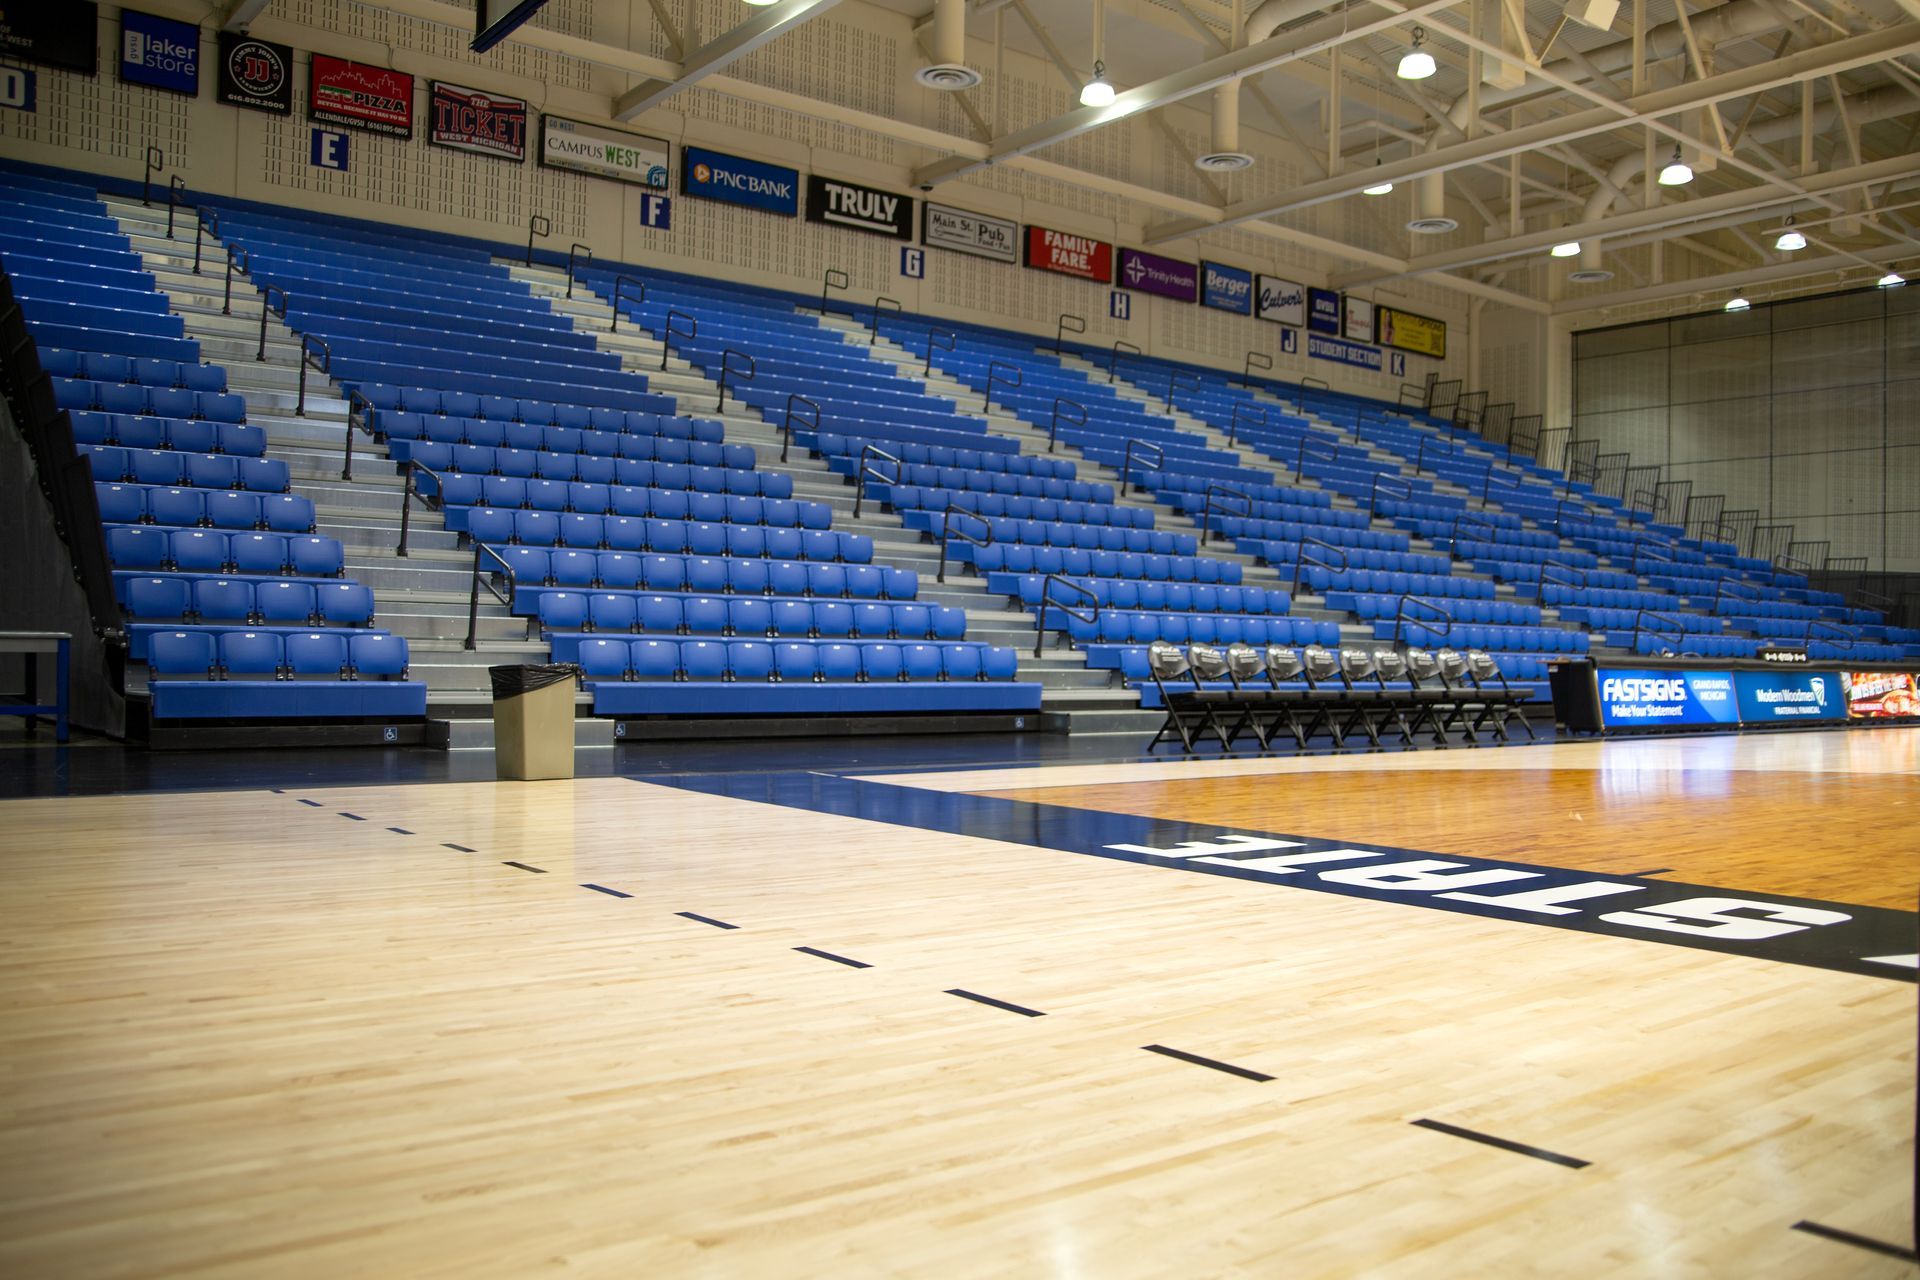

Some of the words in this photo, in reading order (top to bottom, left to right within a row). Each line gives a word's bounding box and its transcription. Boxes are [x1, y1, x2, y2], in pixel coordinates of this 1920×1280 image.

[146, 34, 196, 60] laker
[235, 47, 256, 63] JIMMY
[145, 53, 196, 76] store
[244, 56, 270, 83] JJ
[352, 91, 407, 115] PIZZA
[470, 97, 490, 109] THE
[434, 97, 524, 145] TICKET
[549, 119, 558, 129] GO
[560, 121, 576, 132] WEST
[321, 133, 340, 167] E
[440, 132, 470, 142] WEST
[471, 136, 518, 153] MICHIGAN
[548, 136, 603, 159] CAMPUS
[605, 144, 641, 169] WEST
[652, 174, 667, 187] CW
[649, 196, 663, 226] F
[825, 183, 898, 222] TRULY
[932, 214, 957, 229] Main
[960, 220, 973, 232] St.
[978, 224, 1005, 242] Pub
[1044, 230, 1098, 256] FAMILY
[906, 250, 921, 276] G
[1206, 269, 1250, 295] Berger
[1115, 292, 1127, 318] H
[1261, 288, 1303, 311] Culver's
[1284, 329, 1295, 352] J
[1309, 335, 1346, 359] STUDENT
[1347, 343, 1381, 365] SECTION
[1393, 354, 1403, 375] K
[1756, 688, 1783, 702] Modern
[1782, 688, 1816, 702] Woodmen
[1611, 704, 1631, 717] Make
[1630, 704, 1647, 717] Your
[1102, 834, 1853, 940] STATE
